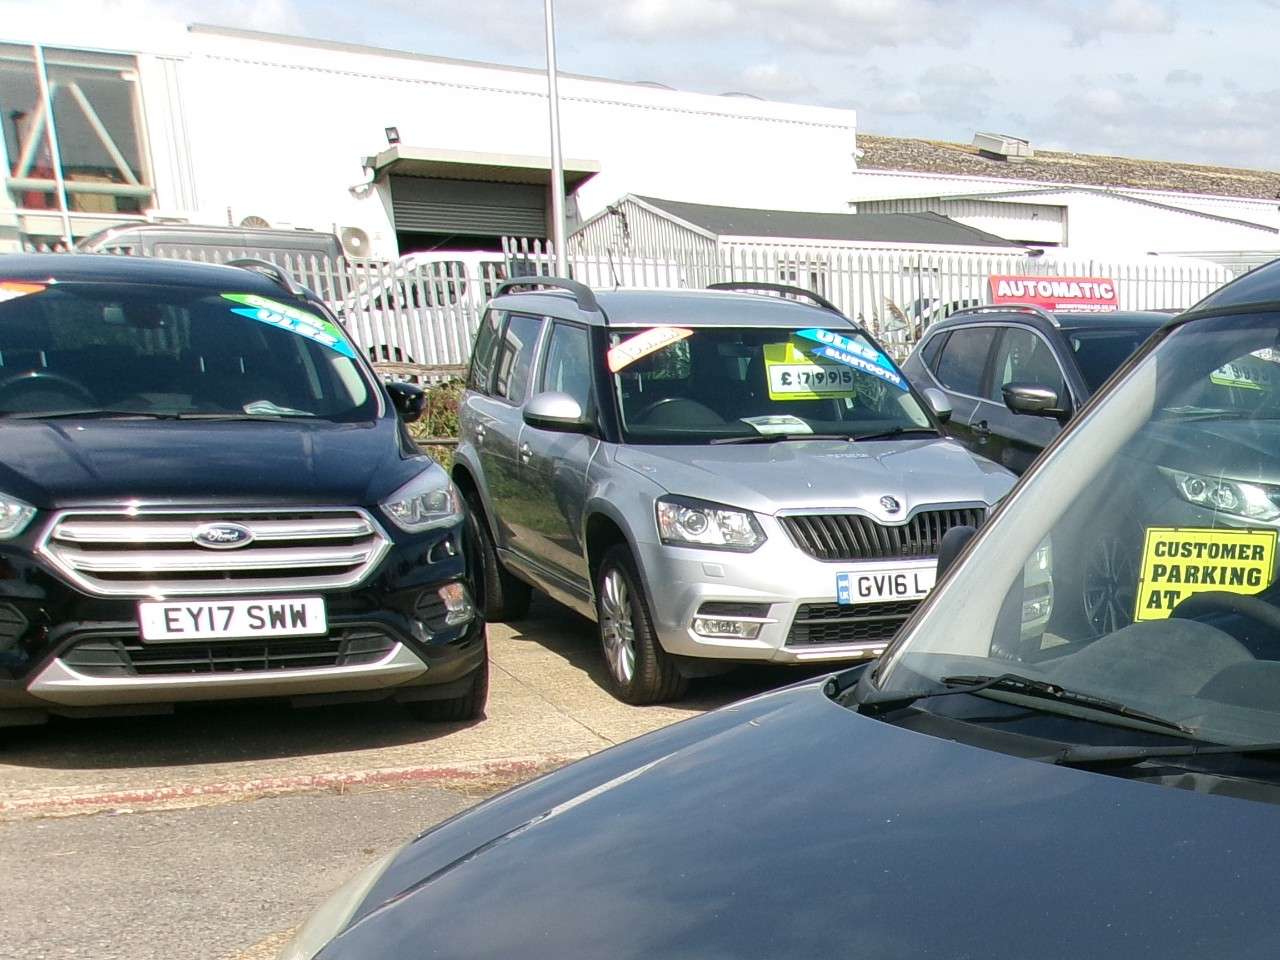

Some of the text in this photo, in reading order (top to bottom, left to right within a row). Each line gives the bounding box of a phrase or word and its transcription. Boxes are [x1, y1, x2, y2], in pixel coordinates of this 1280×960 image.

[998, 280, 1115, 300] AUTOMATIC
[825, 347, 901, 384] BLUETOOTH
[207, 528, 239, 541] Ford
[1154, 541, 1265, 561] CUSTOMER
[858, 573, 928, 597] GV16 L
[1151, 563, 1262, 587] PARKING
[1146, 590, 1181, 610] AT
[163, 603, 308, 633] EY17 SWW
